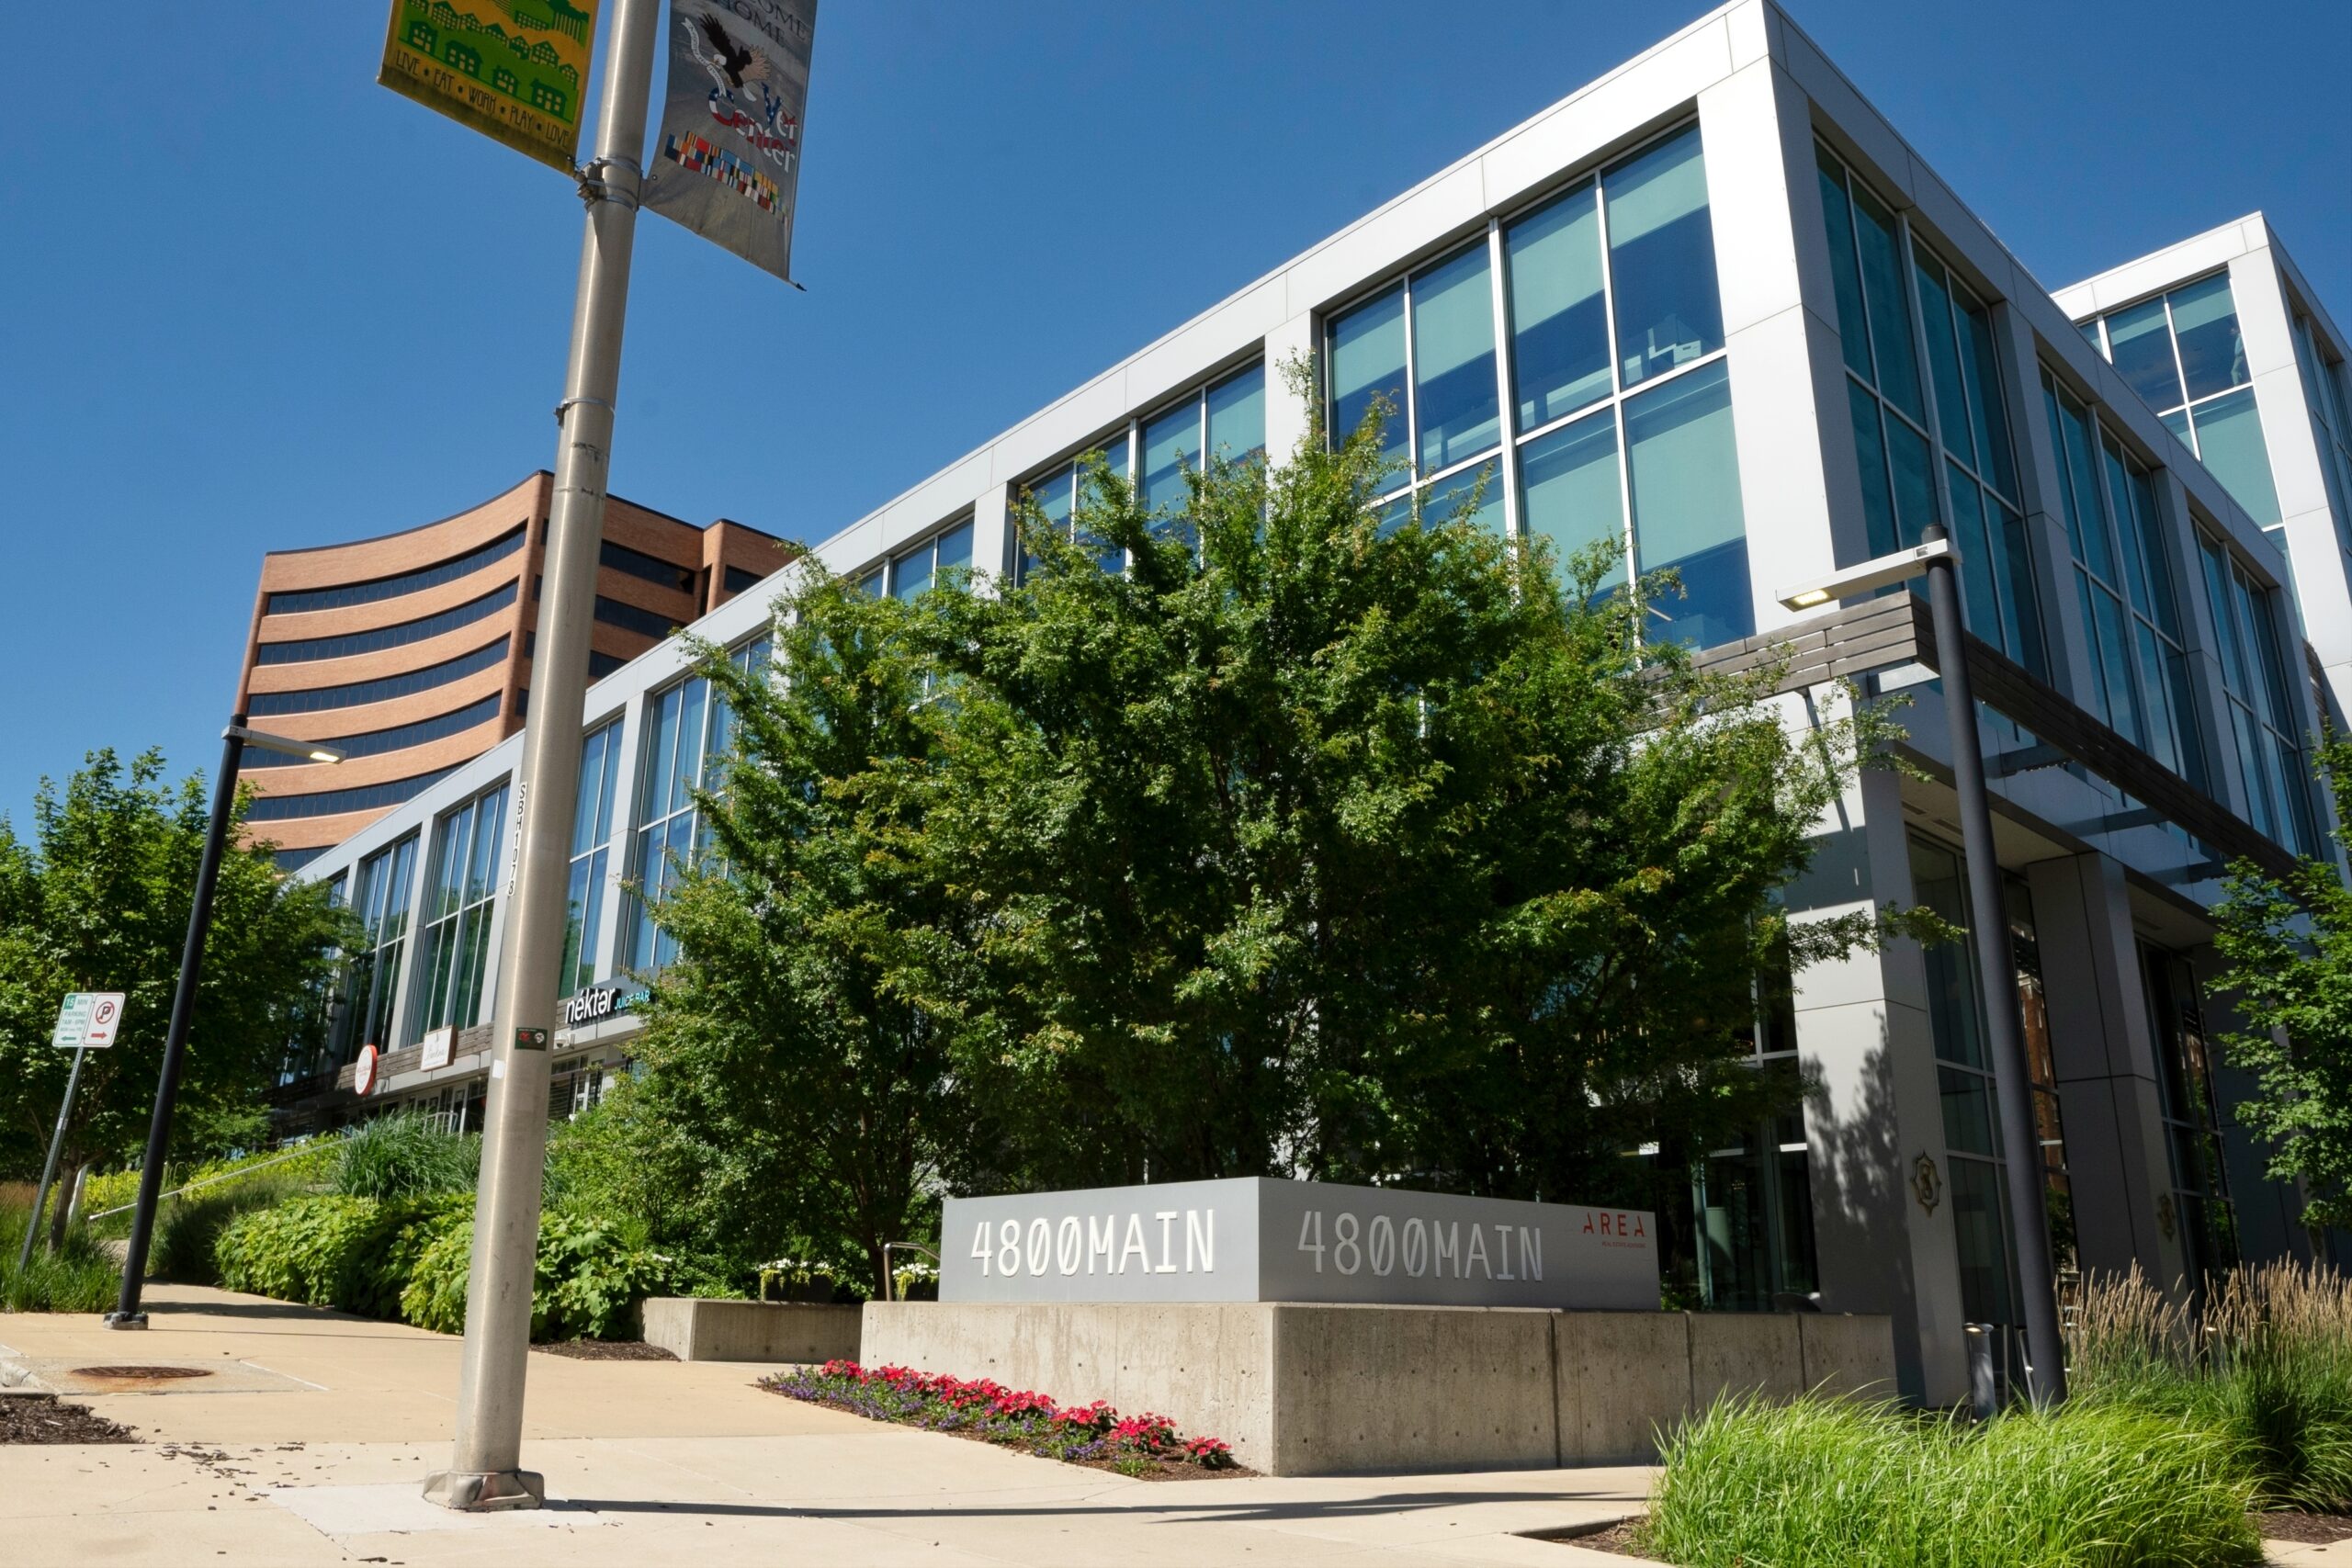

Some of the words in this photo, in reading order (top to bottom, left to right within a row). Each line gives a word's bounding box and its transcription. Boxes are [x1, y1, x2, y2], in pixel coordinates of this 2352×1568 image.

[396, 50, 421, 76] LIVE
[434, 68, 456, 92] EAT
[469, 85, 497, 114] WORK
[509, 105, 534, 130] PLAY
[546, 121, 571, 148] LOVE
[708, 87, 796, 174] Center
[508, 784, 526, 896] SBH1078
[66, 998, 75, 1007] 15
[971, 1208, 1215, 1278] 4800MAIN
[1297, 1210, 1544, 1281] 4800MAIN
[1583, 1212, 1646, 1237] AREA
